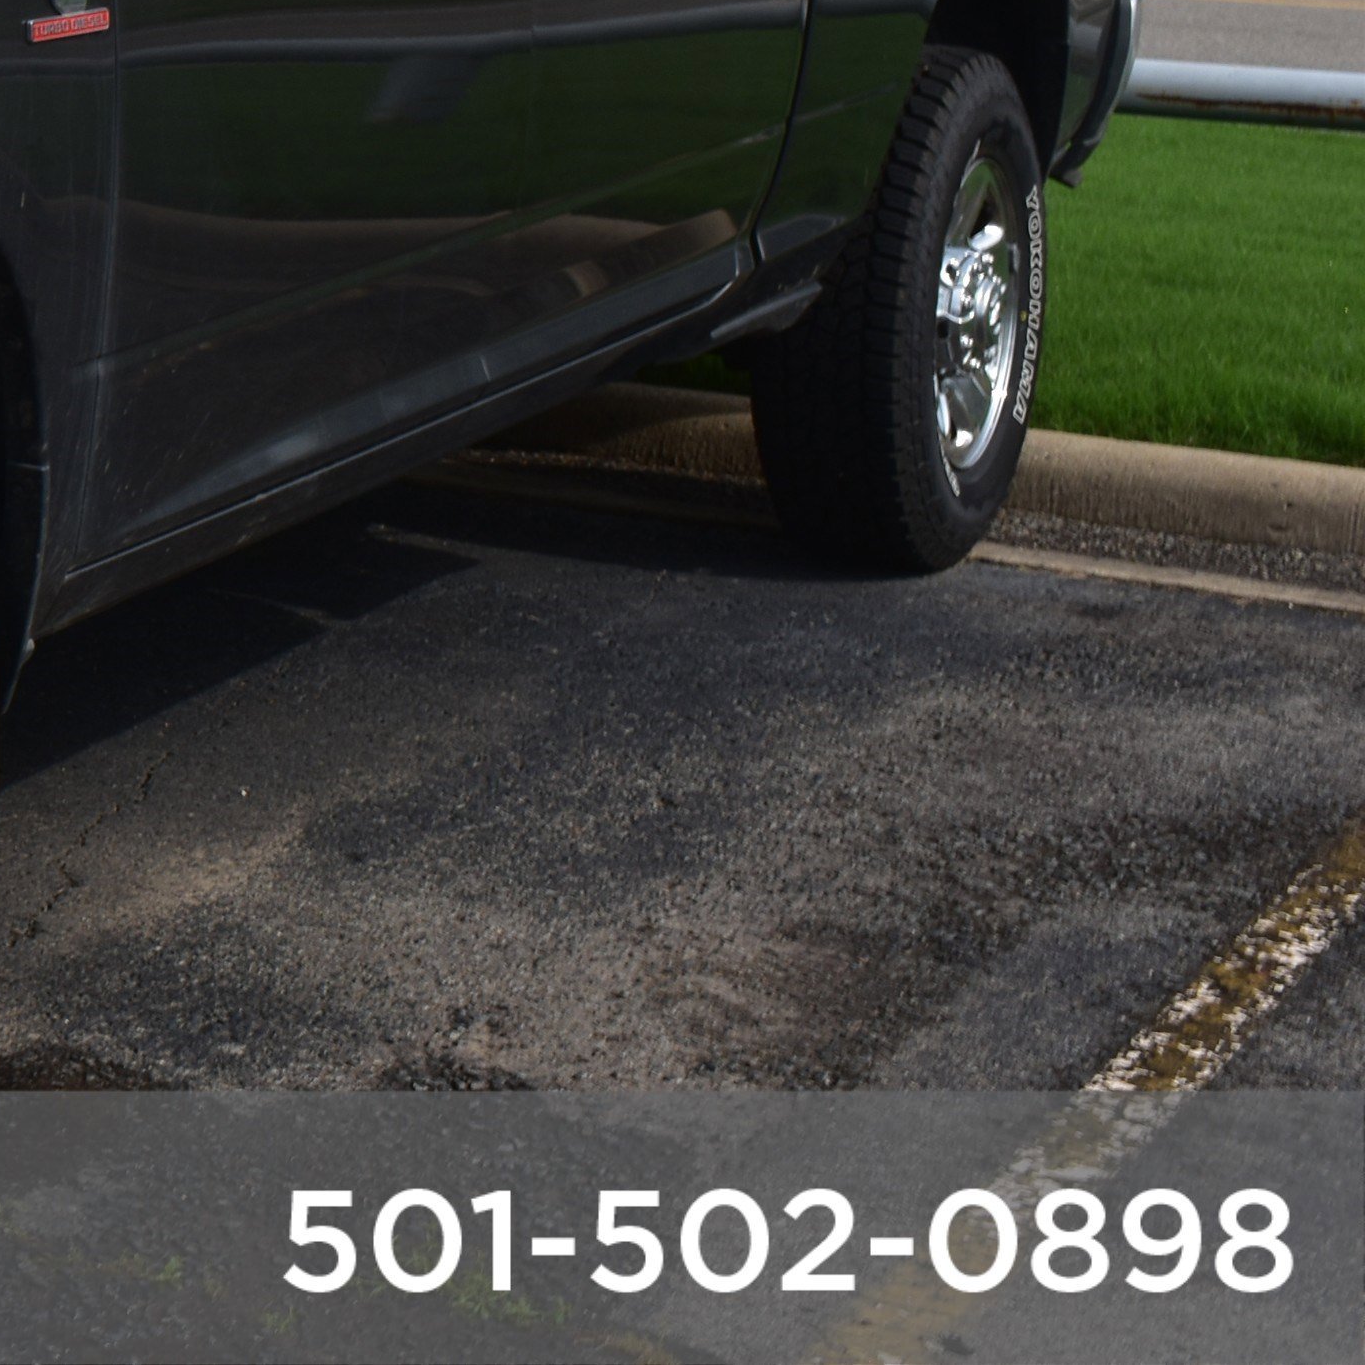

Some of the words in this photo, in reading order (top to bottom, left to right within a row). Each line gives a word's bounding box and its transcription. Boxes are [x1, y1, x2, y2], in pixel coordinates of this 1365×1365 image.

[33, 20, 70, 36] TURBO
[71, 13, 106, 30] DIESEL
[1012, 185, 1043, 425] YOKOHAMA
